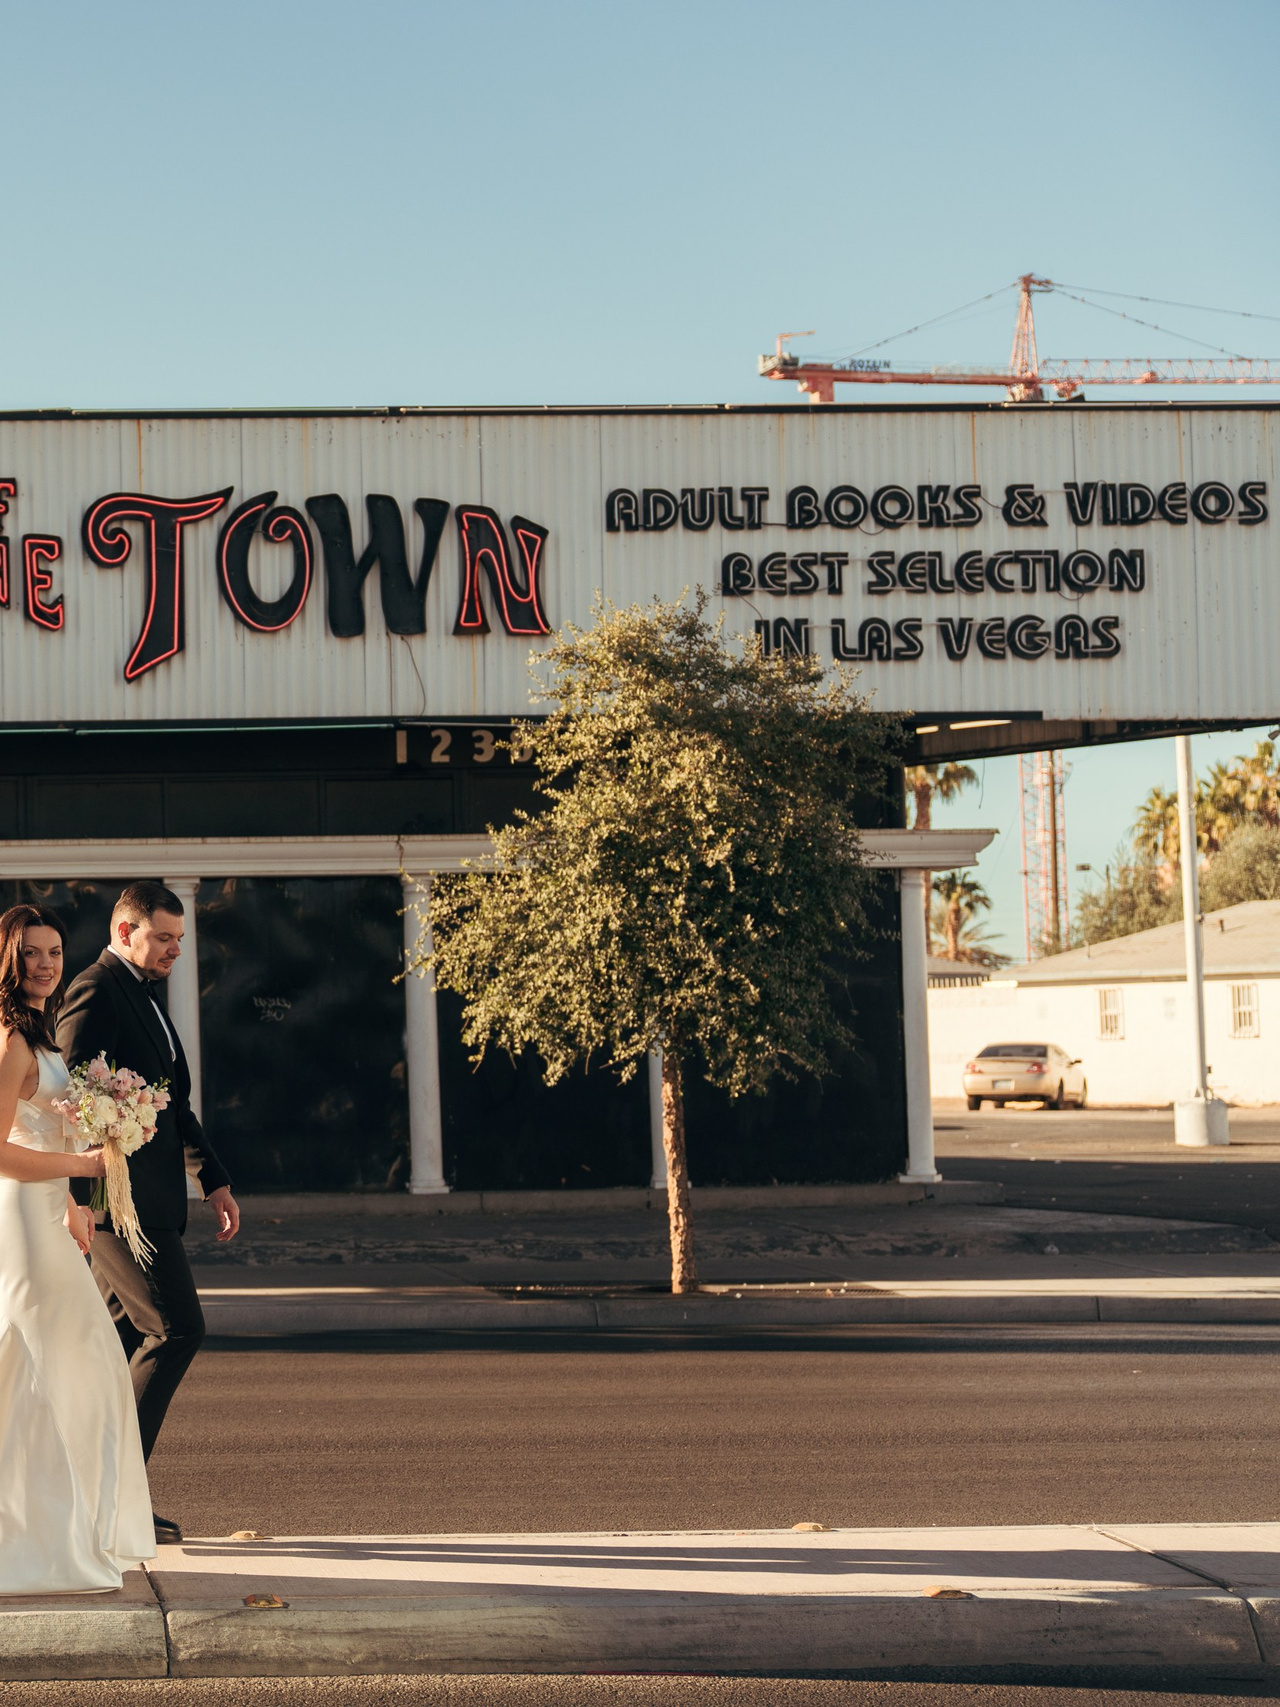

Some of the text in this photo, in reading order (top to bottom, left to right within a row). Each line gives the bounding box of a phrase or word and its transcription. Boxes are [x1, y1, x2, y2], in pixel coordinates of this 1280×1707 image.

[606, 481, 1268, 532] ADULT BOOKS & VIDEOS
[81, 486, 552, 683] TOWN
[721, 549, 1145, 596] BEST SELECTION
[755, 614, 1121, 662] IN LAS VEGAS
